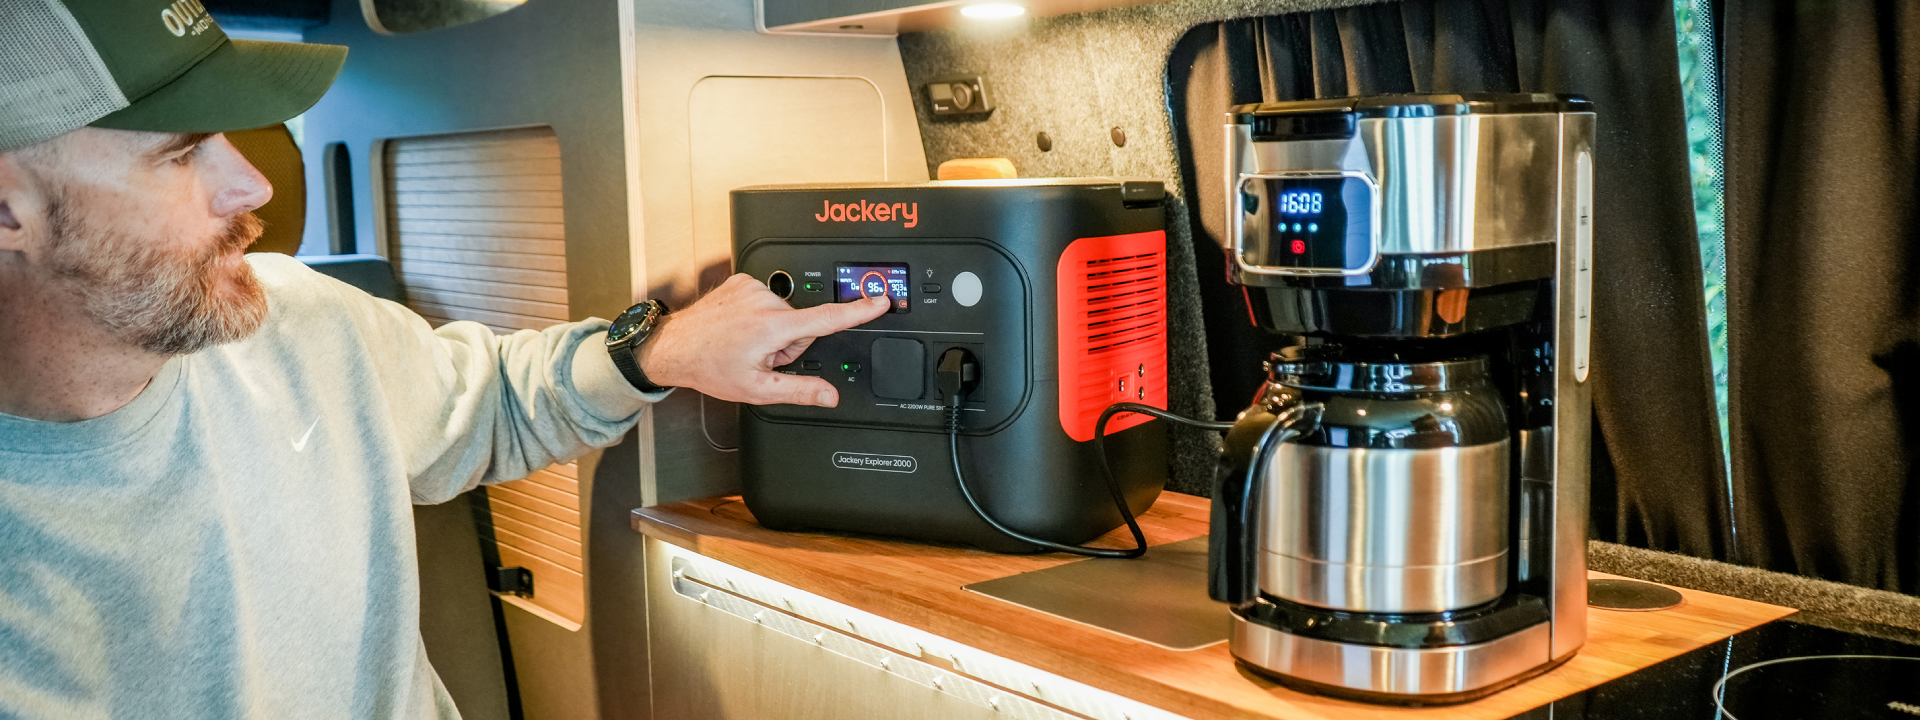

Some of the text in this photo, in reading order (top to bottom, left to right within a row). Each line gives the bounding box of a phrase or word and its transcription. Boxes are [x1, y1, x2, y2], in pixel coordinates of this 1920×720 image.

[815, 199, 918, 229] Jackery
[1281, 192, 1322, 214] 16:08
[837, 455, 912, 468] Jackery Explorer 2000
